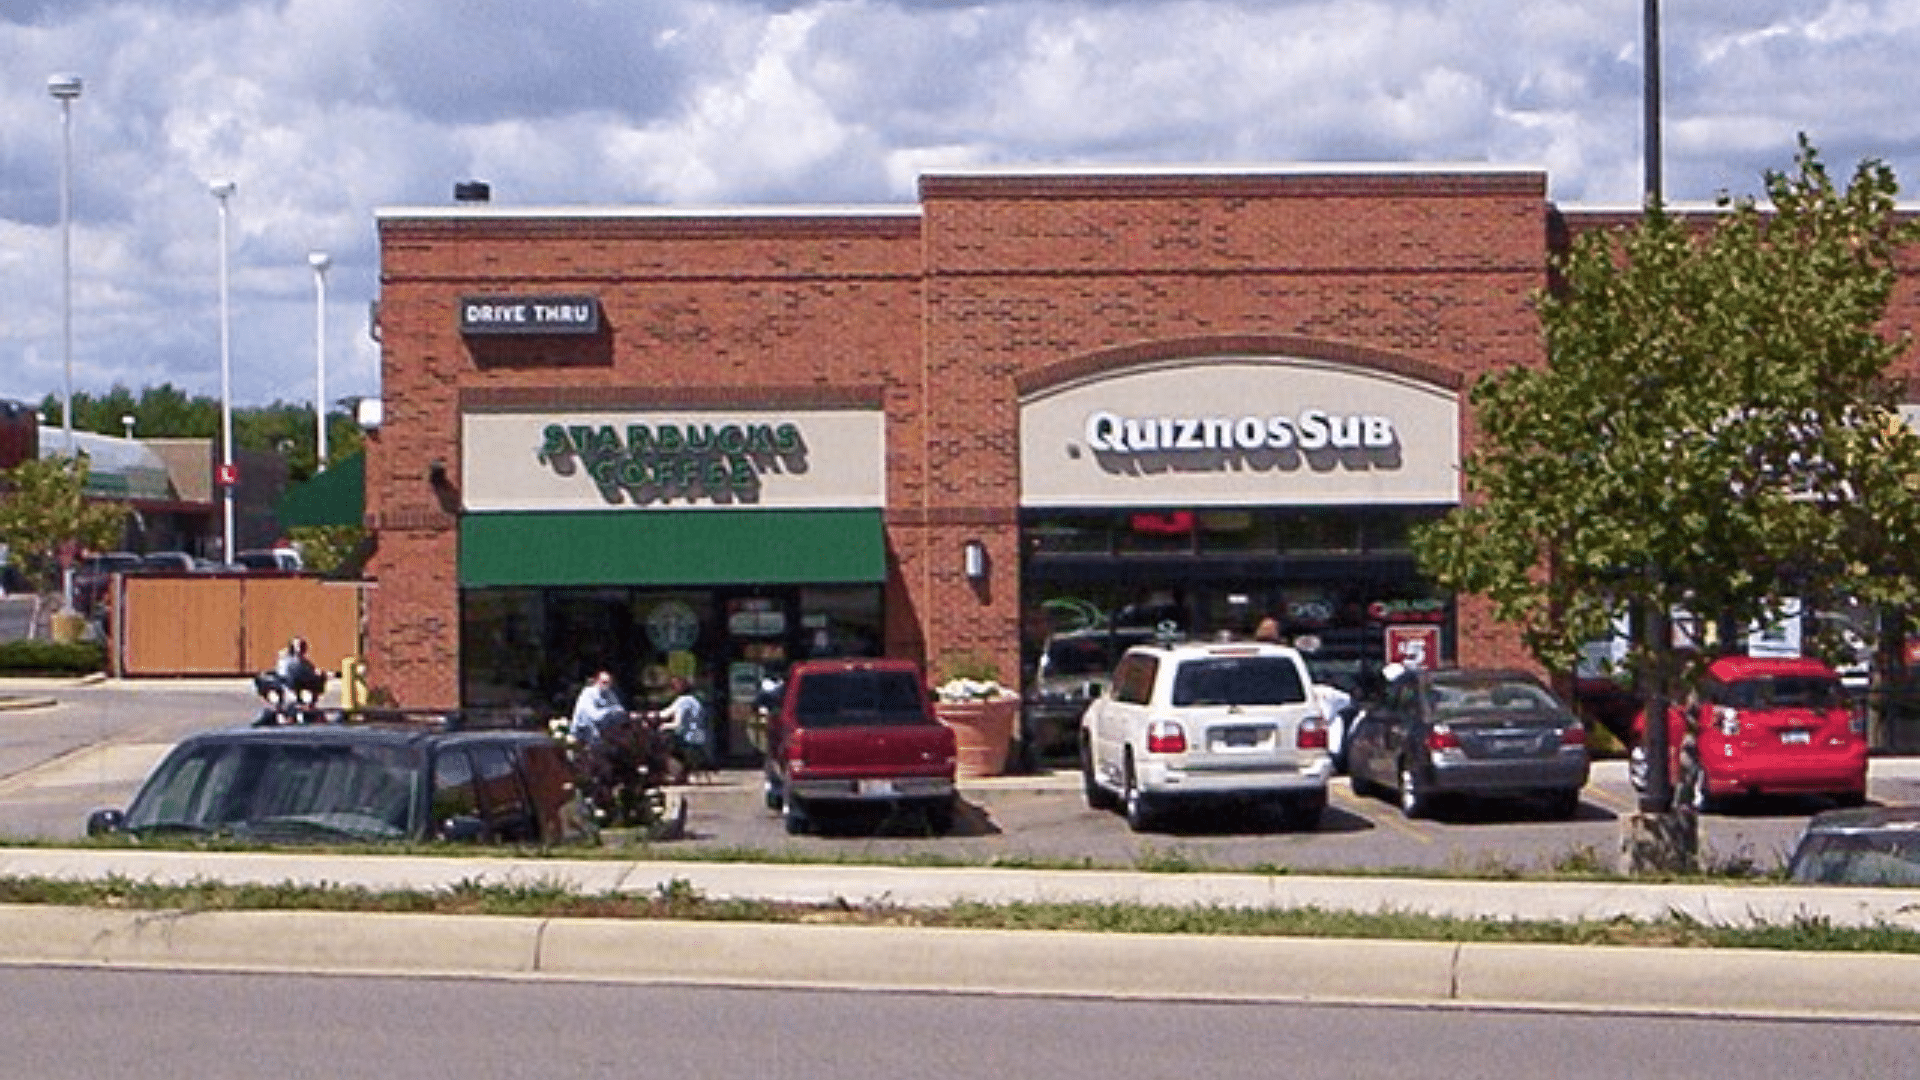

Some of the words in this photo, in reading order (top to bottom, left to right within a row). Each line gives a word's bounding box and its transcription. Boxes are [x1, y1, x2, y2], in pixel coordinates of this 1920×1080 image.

[467, 305, 526, 322] DRIVE
[533, 305, 589, 322] THRU
[543, 423, 798, 452] STARBUCKS
[589, 459, 757, 487] COFFEE
